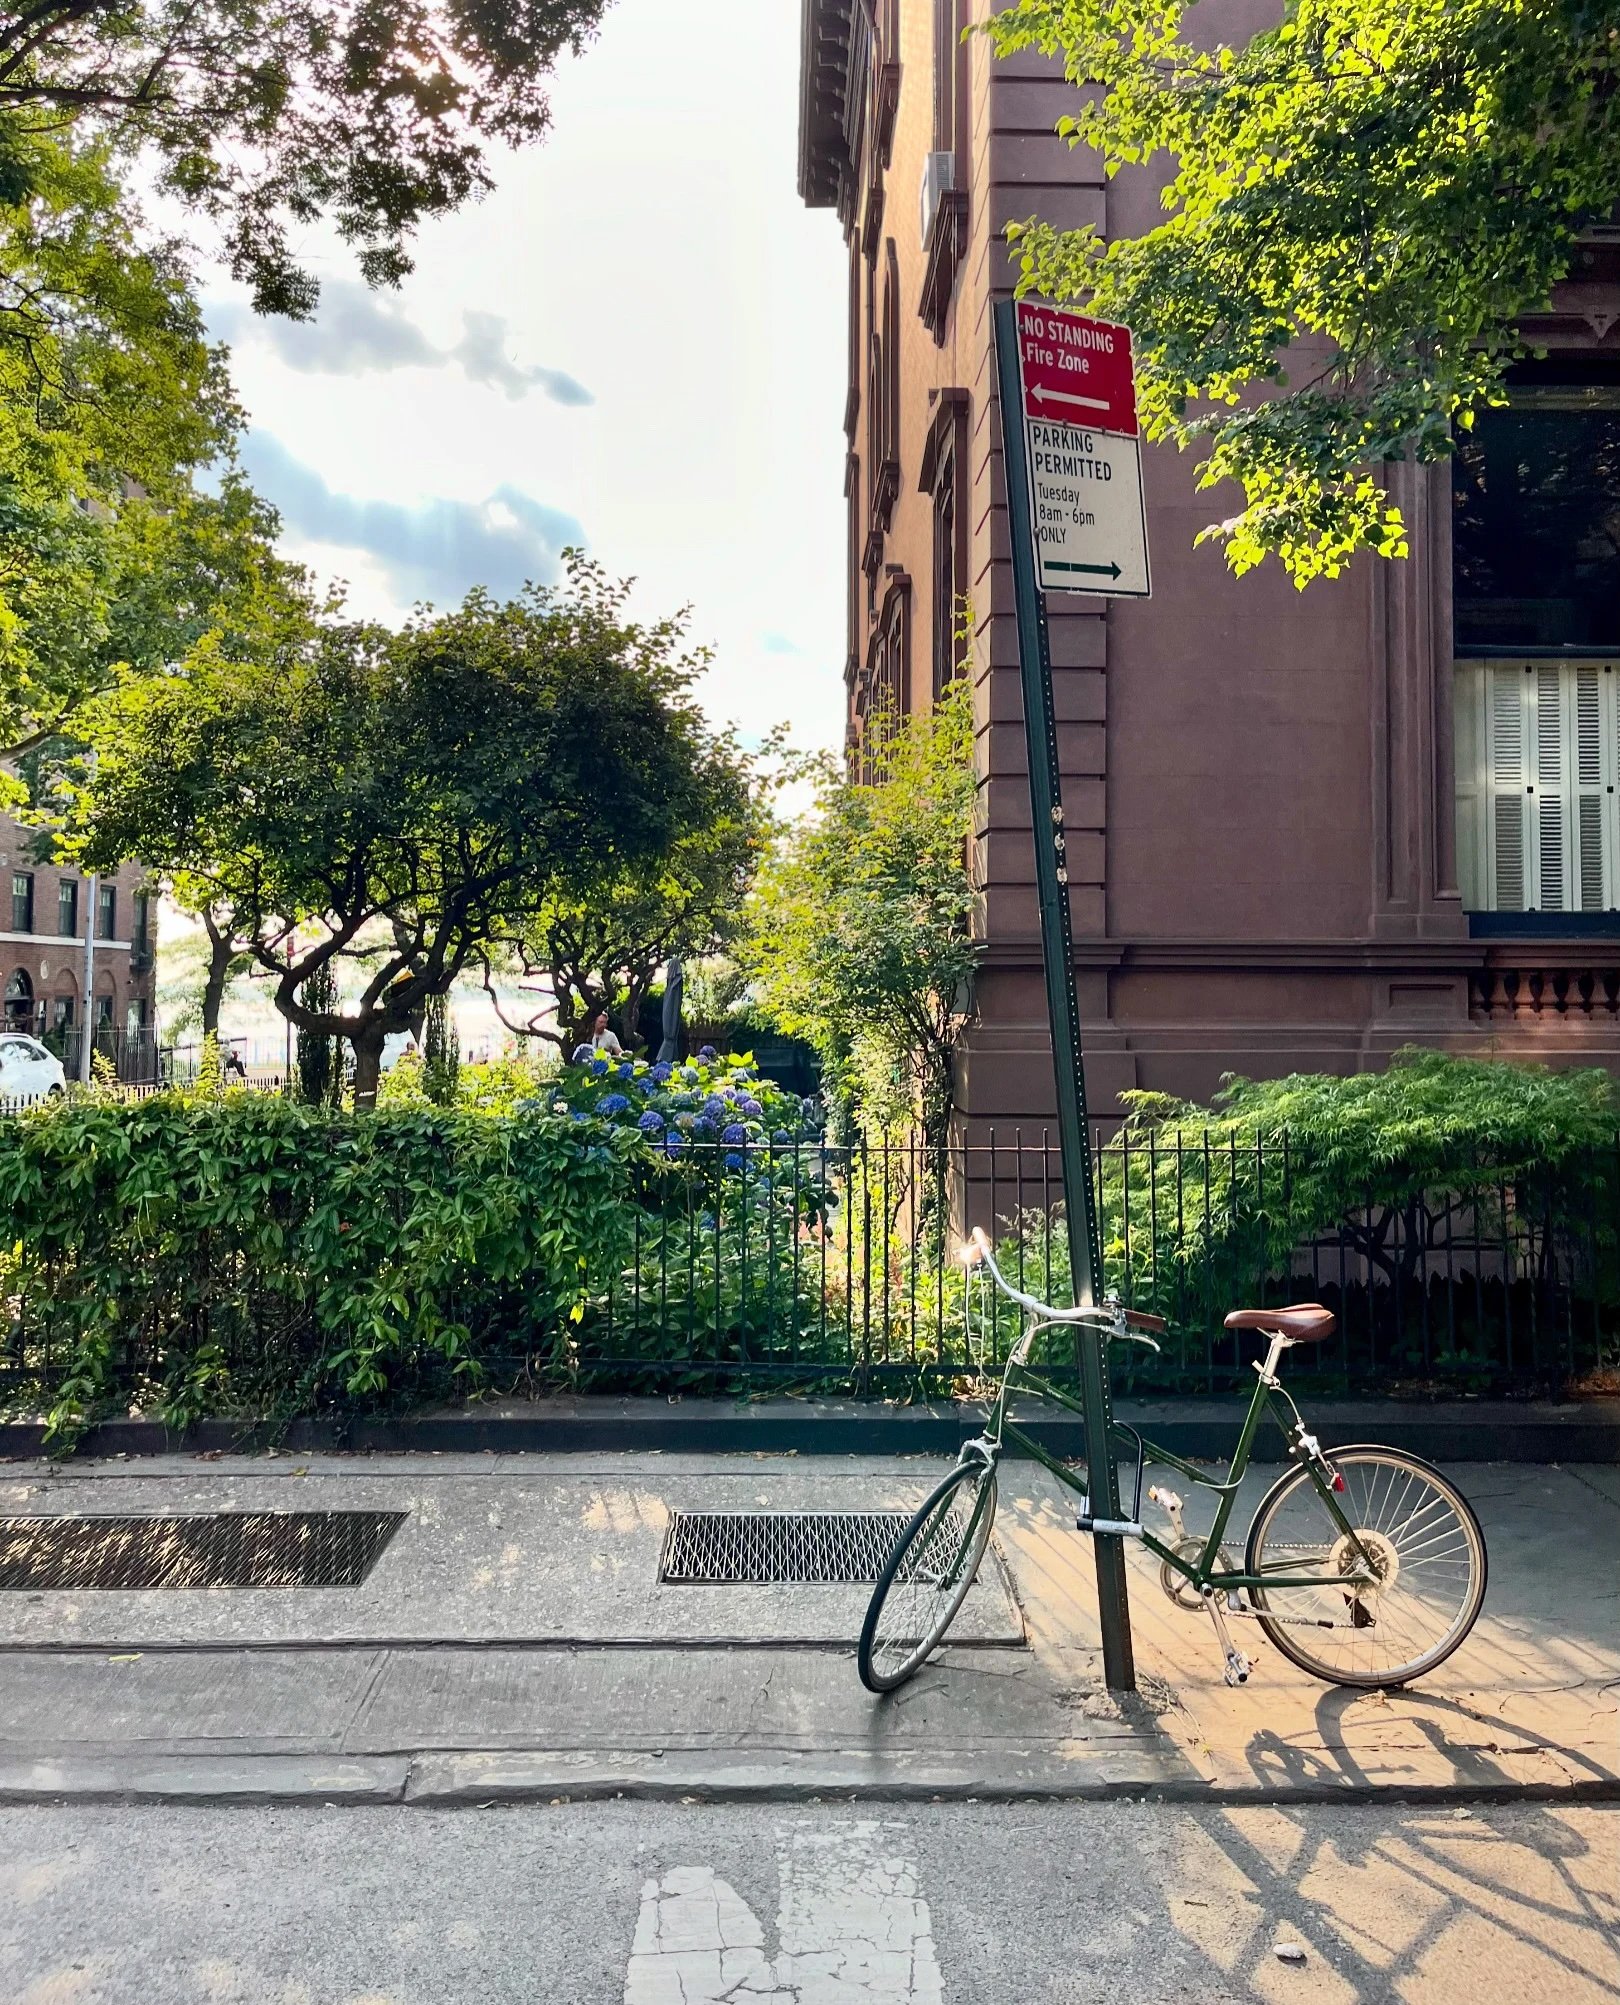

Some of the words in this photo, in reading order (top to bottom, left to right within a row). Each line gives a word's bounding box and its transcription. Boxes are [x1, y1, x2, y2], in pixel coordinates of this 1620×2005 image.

[1024, 315, 1044, 338] NO
[1047, 321, 1114, 353] STANDING
[1026, 342, 1053, 366] Fire
[1057, 349, 1089, 373] Zone
[1033, 425, 1093, 453] PARKING
[1035, 452, 1112, 481] PERMITTED
[1037, 482, 1080, 506] Tuesday
[1039, 503, 1063, 522] 8am
[1072, 507, 1095, 527] 6pm
[1040, 525, 1066, 544] ONLY
